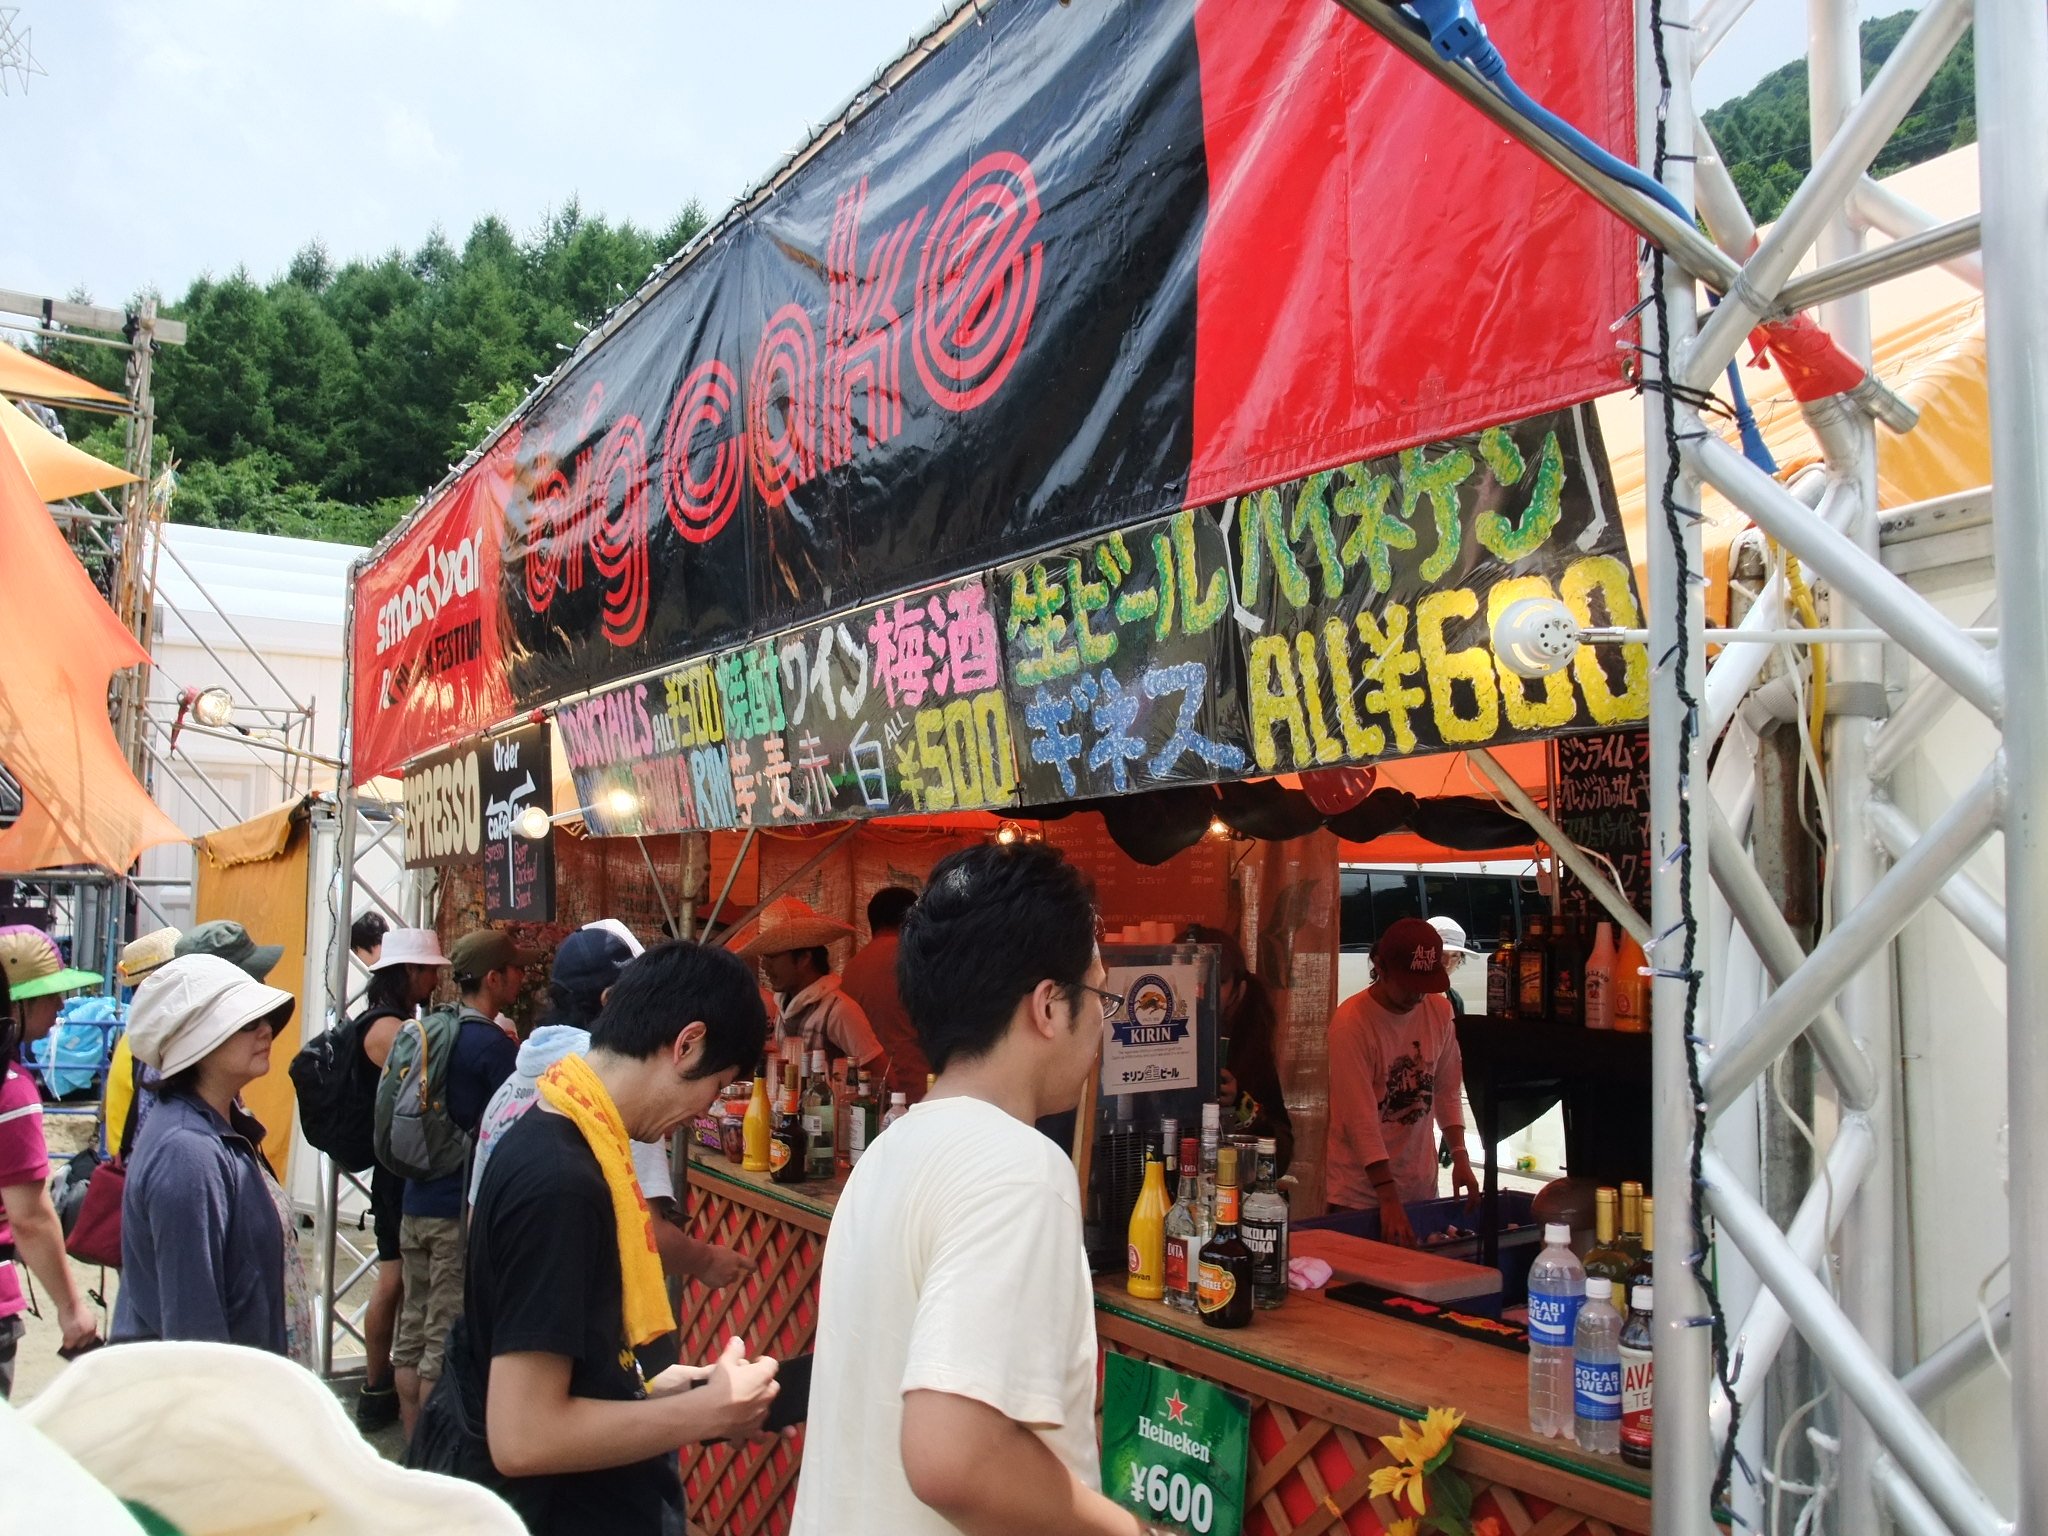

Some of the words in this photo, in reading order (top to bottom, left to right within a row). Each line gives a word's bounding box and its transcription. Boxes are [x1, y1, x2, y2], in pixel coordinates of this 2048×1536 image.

[1240, 427, 1565, 608] ハイネケン
[1007, 510, 1229, 687] 生ビール
[781, 622, 868, 727] ワイン
[868, 583, 997, 708] 梅酒
[652, 713, 676, 753] ALL
[664, 665, 724, 748] ¥500
[1250, 617, 1385, 772] ALL
[493, 736, 520, 772] Order
[884, 711, 910, 749] ALL
[895, 689, 1015, 812] ¥500
[1025, 661, 1246, 797] ギネス
[403, 750, 481, 863] ESPRESSO
[1130, 1027, 1171, 1044] KIRIN
[1122, 1064, 1180, 1083] キリン生ビール
[1167, 1242, 1184, 1260] DITA
[1242, 1238, 1275, 1254] ODKA
[1575, 1367, 1619, 1382] POCAR
[1575, 1377, 1620, 1393] SWEAT
[1632, 1391, 1653, 1408] TE
[1138, 1415, 1211, 1463] Heineken
[1130, 1461, 1214, 1534] ¥600
